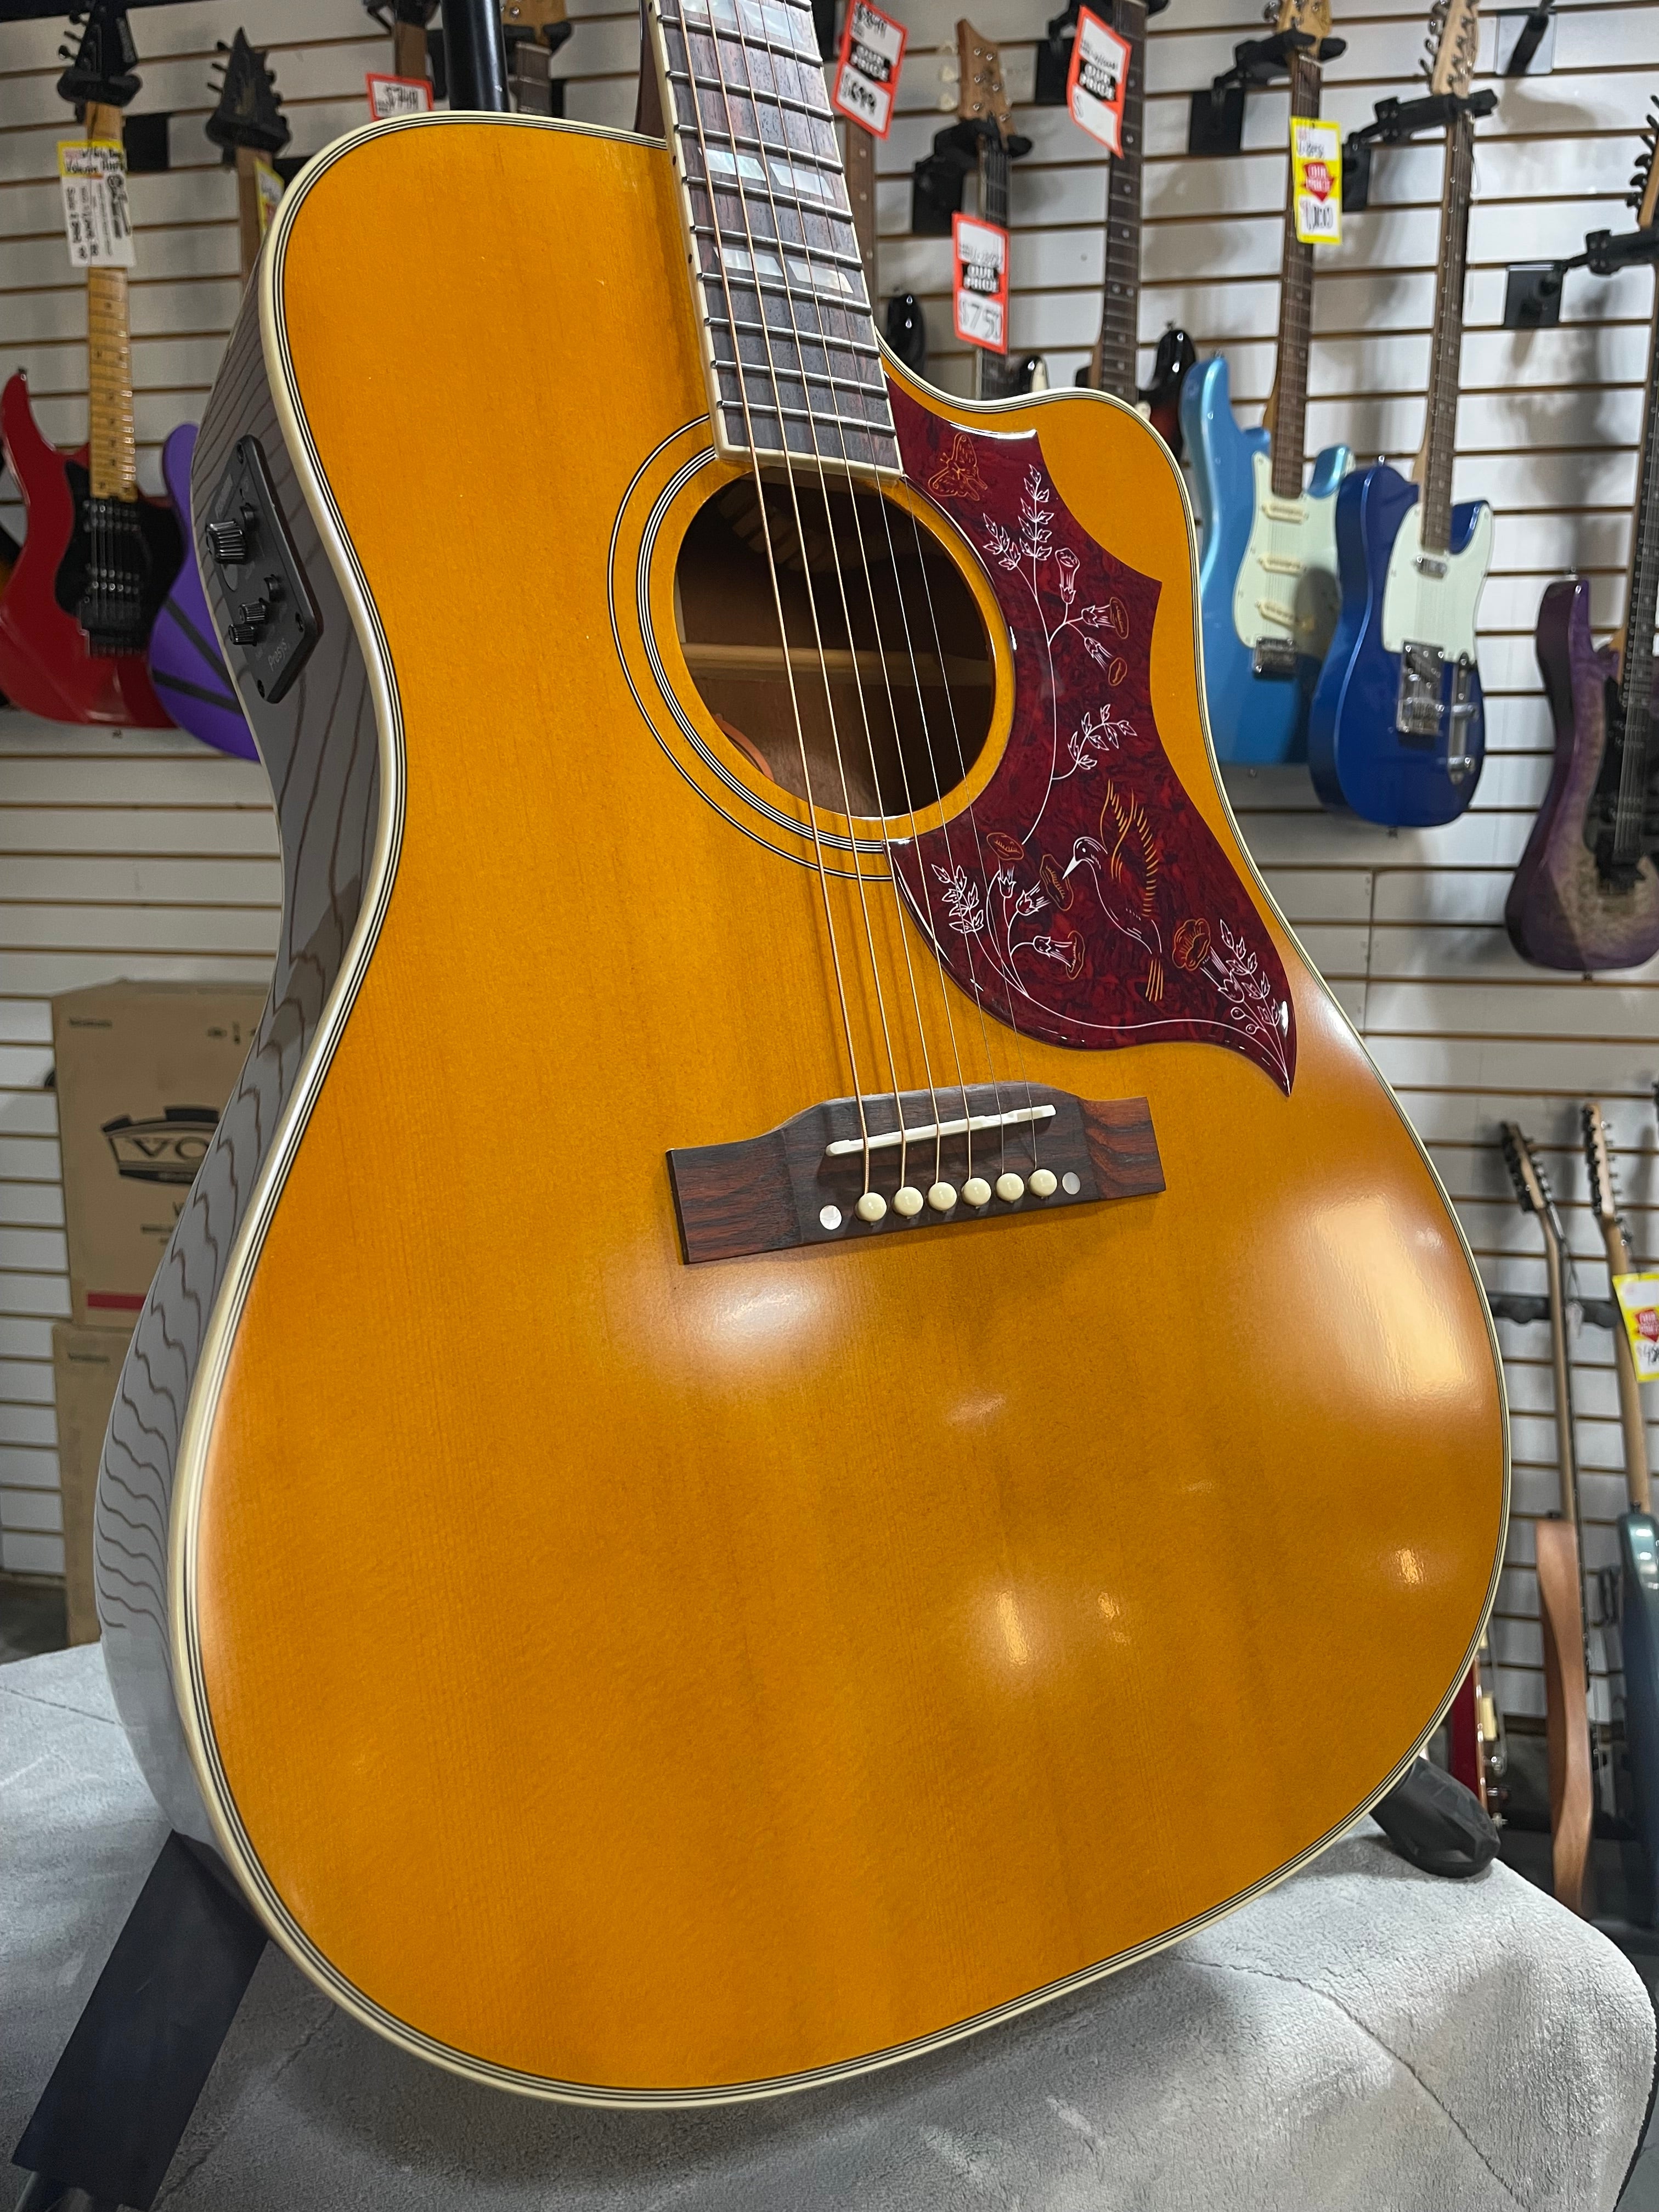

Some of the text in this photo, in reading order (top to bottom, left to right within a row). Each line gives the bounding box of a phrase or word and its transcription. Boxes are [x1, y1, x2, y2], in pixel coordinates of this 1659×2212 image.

[856, 43, 884, 65] OUR
[850, 51, 889, 82] PRICE
[1084, 63, 1111, 84] OUR
[1079, 71, 1115, 101] PRICE
[967, 263, 994, 279] OUR
[963, 275, 998, 292] PRICE
[268, 637, 287, 672] Presys
[126, 1136, 210, 1160] VO
